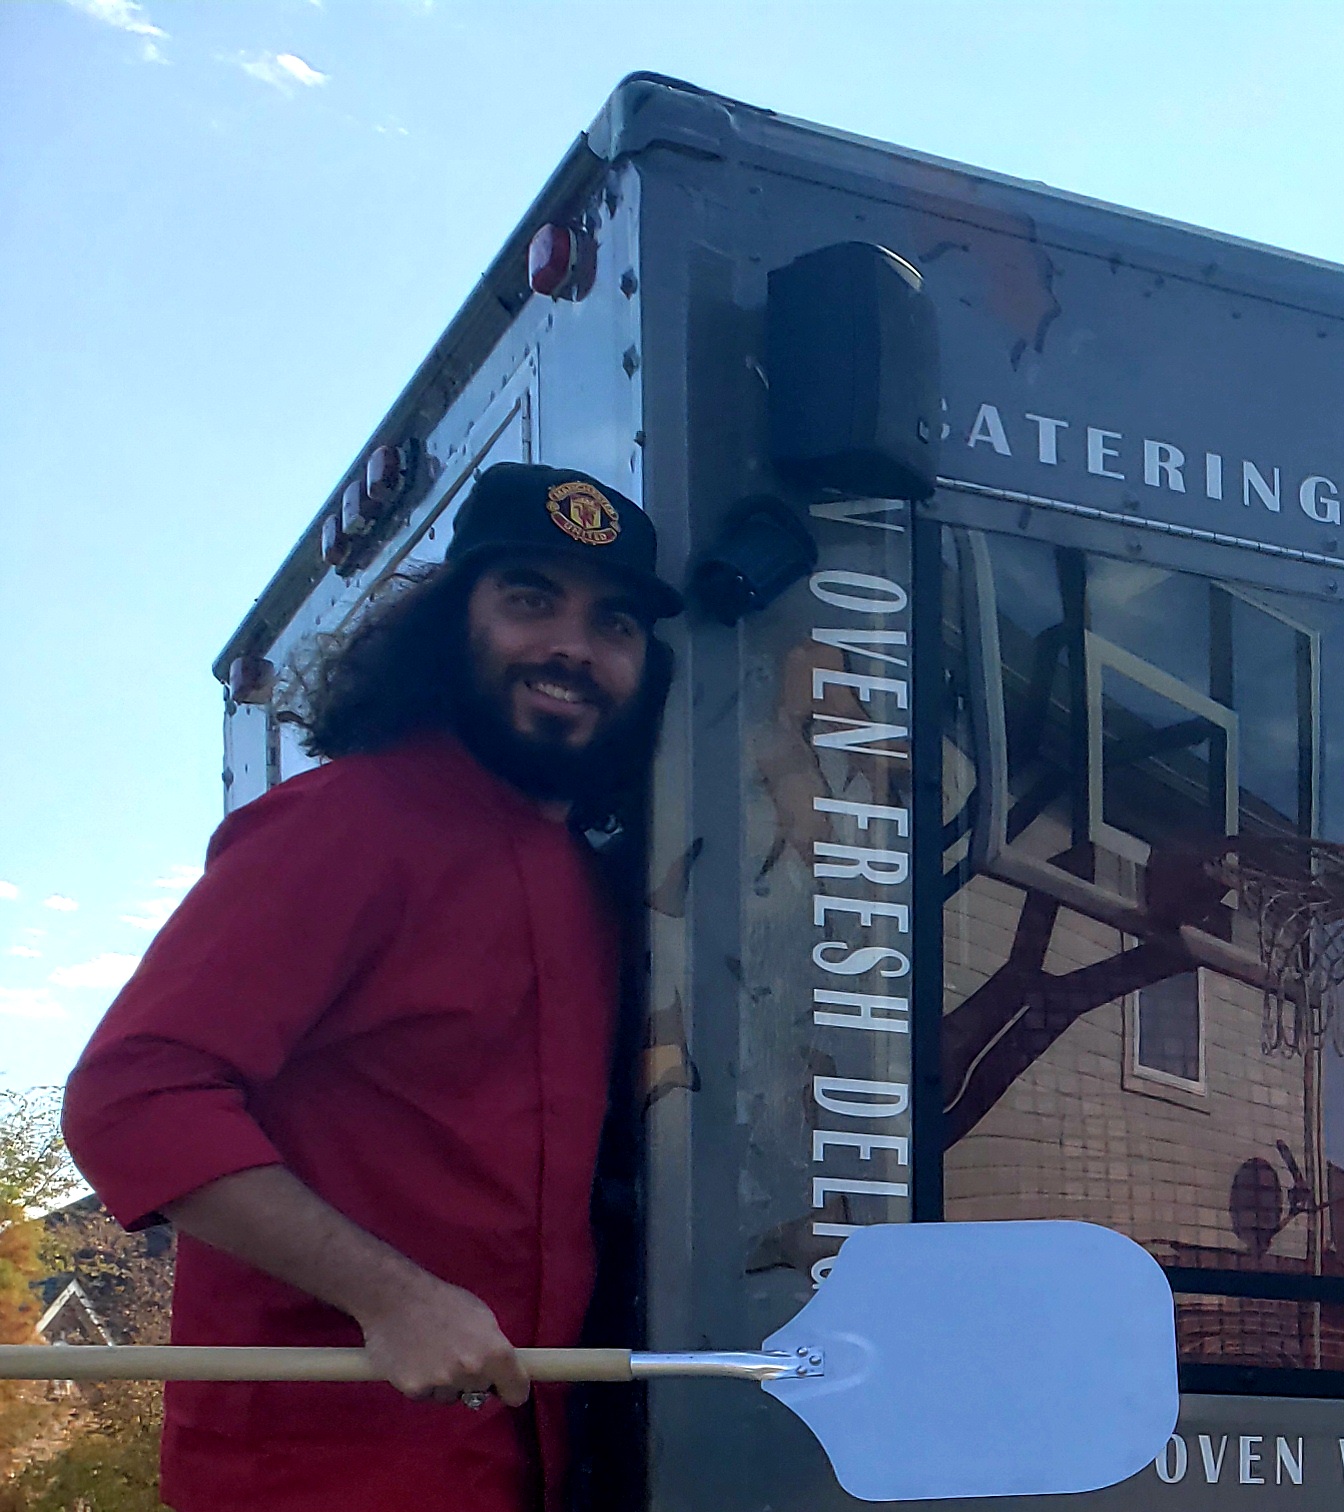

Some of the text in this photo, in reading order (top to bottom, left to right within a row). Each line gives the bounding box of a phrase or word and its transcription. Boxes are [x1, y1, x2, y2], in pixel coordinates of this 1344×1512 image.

[809, 569, 908, 759] OVEN
[812, 796, 910, 1034] FRESH
[1155, 1433, 1304, 1486] OVEN
